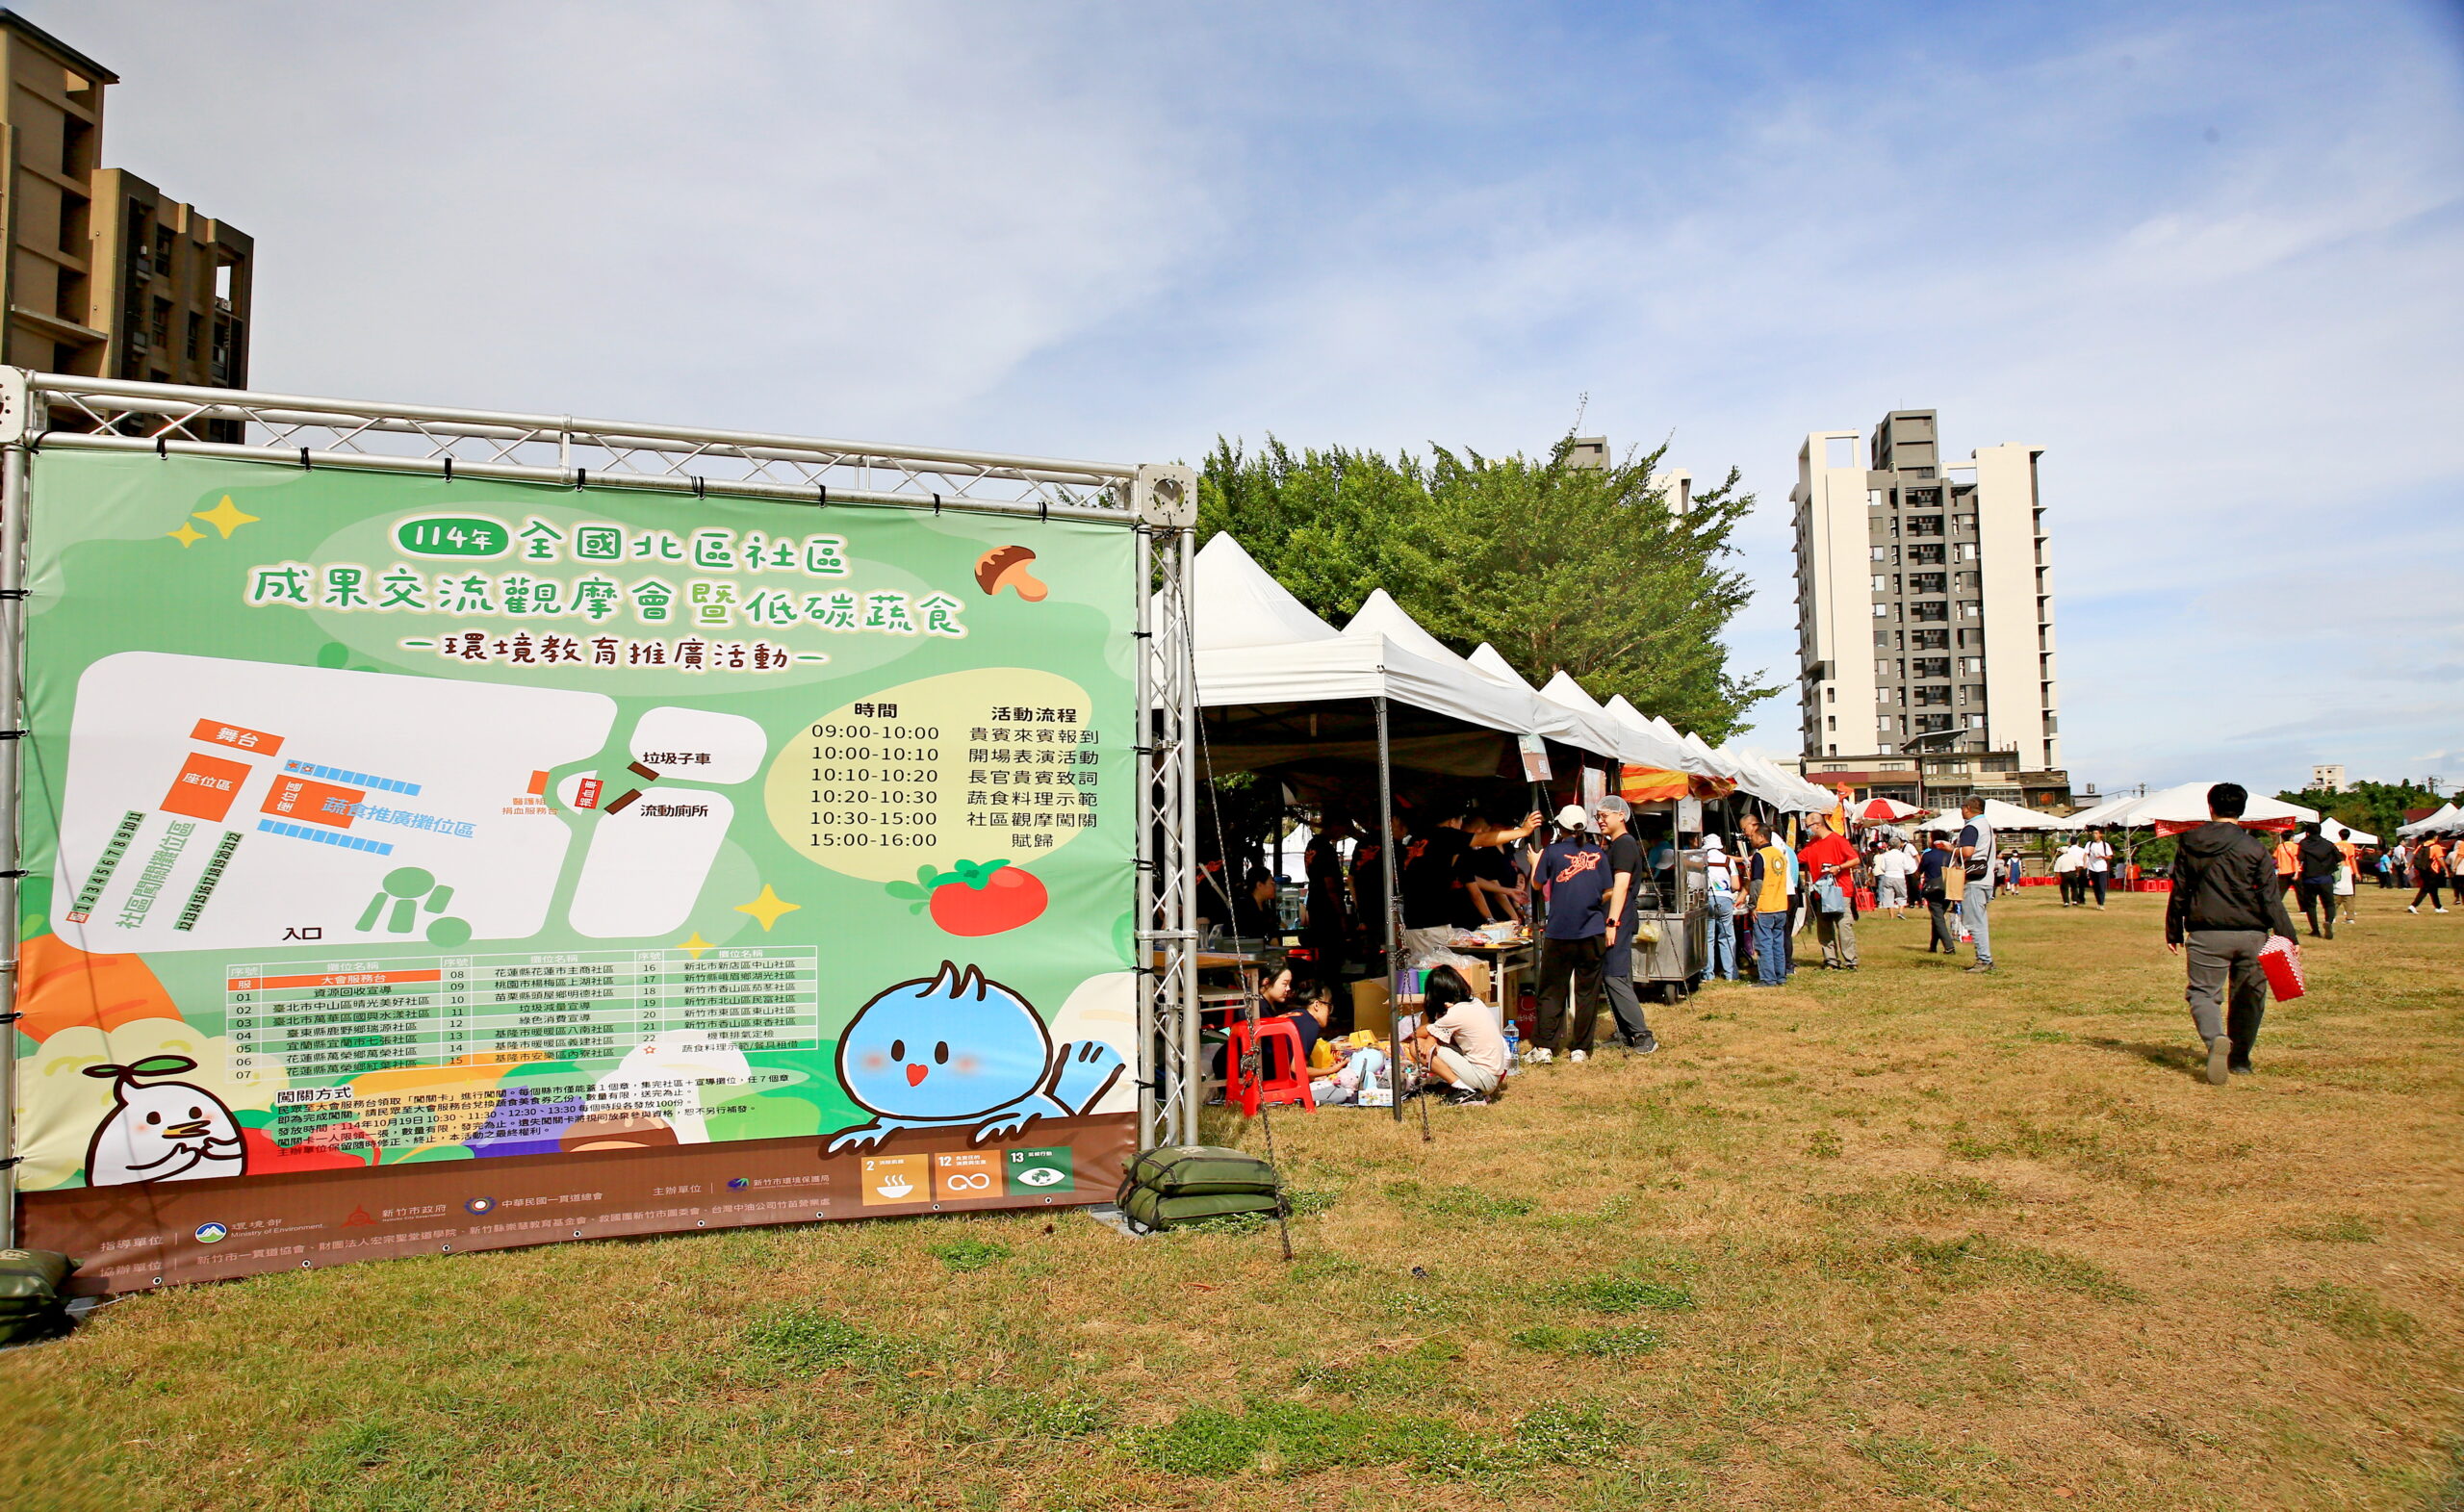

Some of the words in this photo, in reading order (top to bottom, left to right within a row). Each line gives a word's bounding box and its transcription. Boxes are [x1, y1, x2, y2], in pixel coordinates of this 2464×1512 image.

[413, 523, 494, 551] 114年
[515, 523, 843, 575] 全國北區社區
[252, 568, 963, 634] 成果交流觀摩會暨低碳蔬食
[854, 703, 897, 719] 時間
[991, 705, 1077, 723] 活動流程
[216, 727, 259, 748] 舞台
[811, 724, 939, 740] 09:00-10:00
[969, 727, 1099, 745] 貴賓來賓報到
[642, 752, 711, 765] 垃圾子車
[811, 746, 938, 761] 10:00-10:10
[968, 748, 1099, 766] 開場表演活動
[811, 767, 938, 782] 10:10-10:20
[968, 770, 1098, 786] 長官貴賓致詞
[182, 772, 233, 791] 座位區
[276, 781, 304, 813] 座位區
[810, 789, 937, 805] 10:20-10:30
[967, 790, 1098, 807] 蔬食料理示範
[640, 804, 708, 817] 流動廁所
[321, 796, 477, 839] 蔬食推廣攤位區
[810, 811, 937, 826] 10:30-15:00
[967, 811, 1097, 828] 社區觀摩闖關
[809, 833, 937, 847] 15:00-16:00
[1012, 833, 1054, 848] 賦歸
[282, 927, 322, 941] 入口
[643, 963, 656, 972] 16
[684, 960, 796, 971] 新北市新店區中山社區
[321, 974, 387, 986] 大會服務台
[450, 970, 464, 979] 08
[643, 975, 655, 984] 17
[238, 980, 252, 989] 服
[450, 982, 464, 990] 09
[494, 976, 614, 989] 桃園市楊梅區上湖社區
[236, 992, 251, 1002] 01
[314, 986, 393, 997] 資源回收宣導
[494, 988, 614, 1002] 苗栗縣頭屋鄉明德社區
[643, 987, 656, 995] 18
[450, 995, 464, 1004] 10
[236, 1006, 252, 1014] 02
[451, 1008, 463, 1016] 11
[519, 1002, 590, 1012] 垃圾減量宣導
[236, 1018, 252, 1028] 03
[449, 1019, 463, 1028] 12
[519, 1013, 591, 1025] 綠色消費宣導
[494, 1024, 614, 1038] 基隆市暖暖區八南社區
[643, 1022, 654, 1031] 21
[236, 1032, 252, 1040] 04
[286, 1034, 418, 1051] 宜蘭縣宜蘭市七張社區
[449, 1032, 463, 1040] 13
[643, 1034, 656, 1042] 22
[236, 1044, 252, 1054] 05
[286, 1046, 418, 1064] 花蓮縣萬榮鄉萬榮社區
[236, 1058, 252, 1066] 06
[236, 1070, 252, 1080] 07
[277, 1086, 352, 1104] 闖關方式
[938, 1155, 953, 1166] 12
[1011, 1151, 1024, 1164] 13
[866, 1160, 875, 1171] 2
[653, 1184, 702, 1196] 主辦單位
[382, 1204, 447, 1218] 新竹市政府
[231, 1229, 262, 1239] Ministry
[273, 1223, 323, 1233] Environment
[100, 1235, 164, 1252] 指導單位
